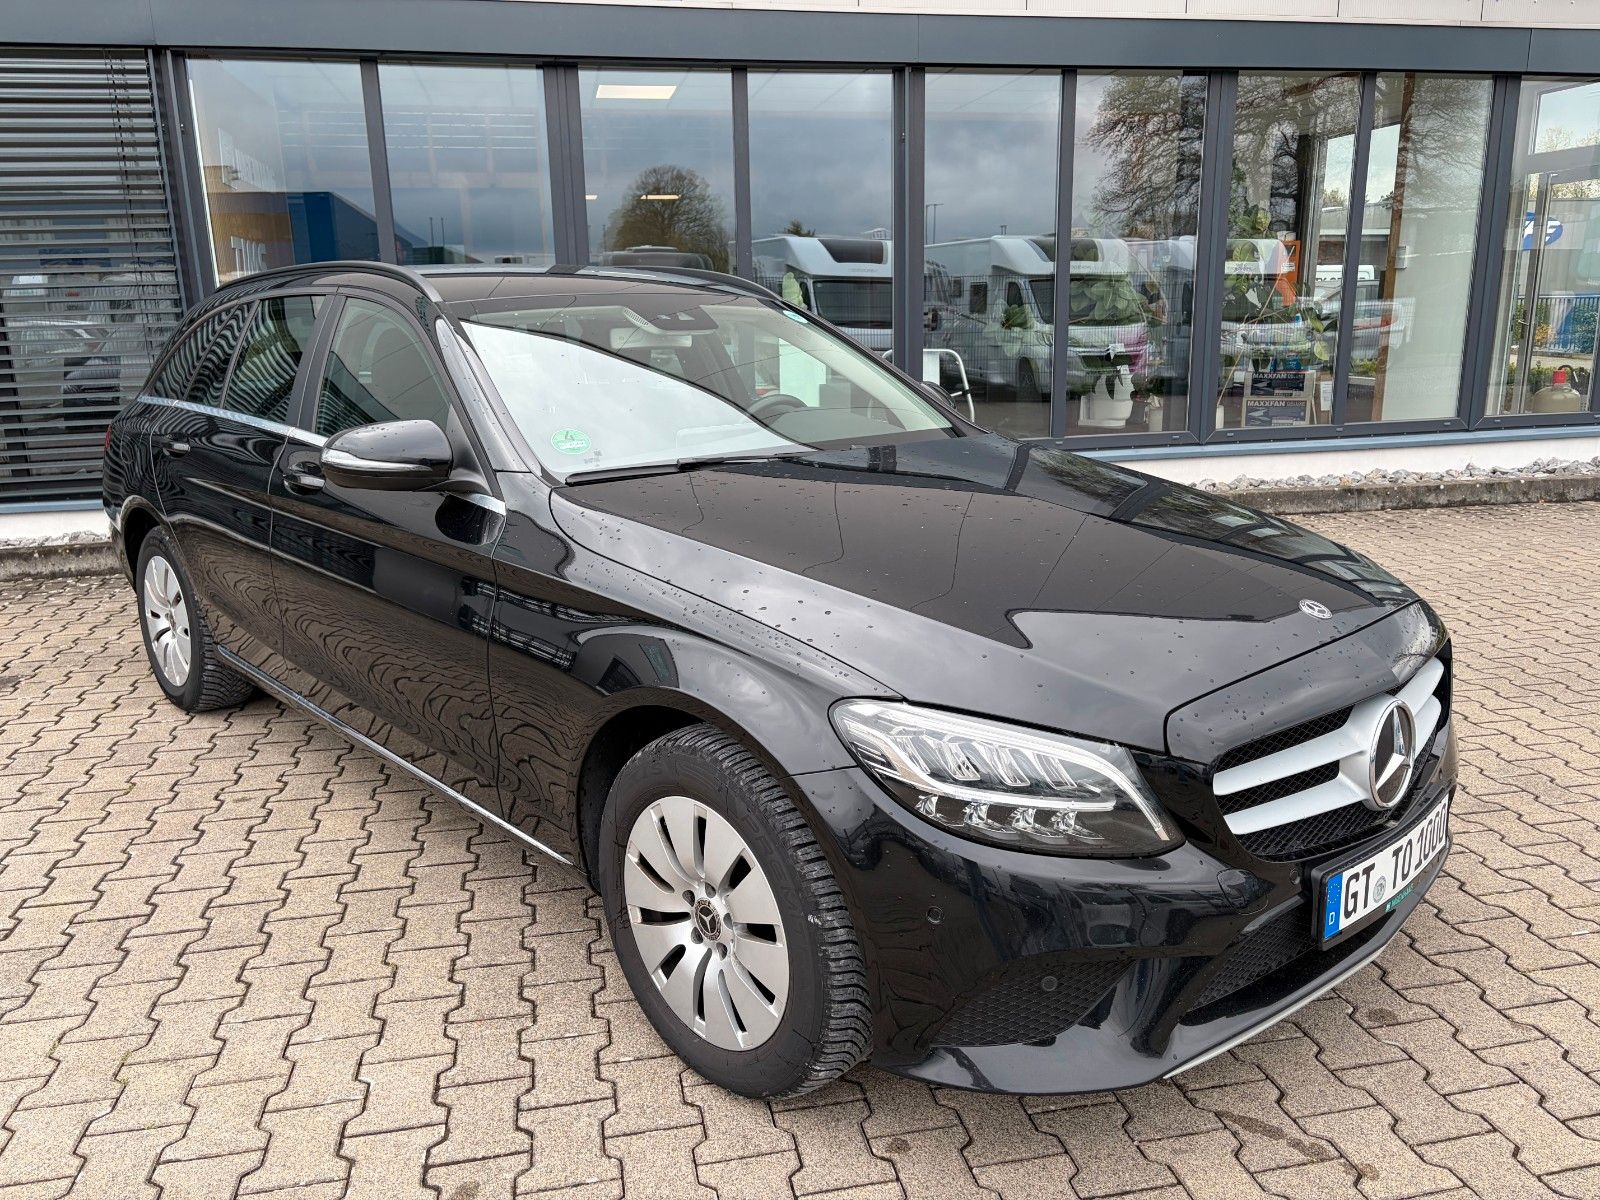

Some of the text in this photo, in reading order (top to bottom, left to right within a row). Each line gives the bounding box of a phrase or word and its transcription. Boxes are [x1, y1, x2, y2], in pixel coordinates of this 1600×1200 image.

[1343, 861, 1376, 920] GT
[1392, 838, 1414, 890] TO
[1414, 801, 1447, 872] 1000
[1328, 911, 1336, 926] D
